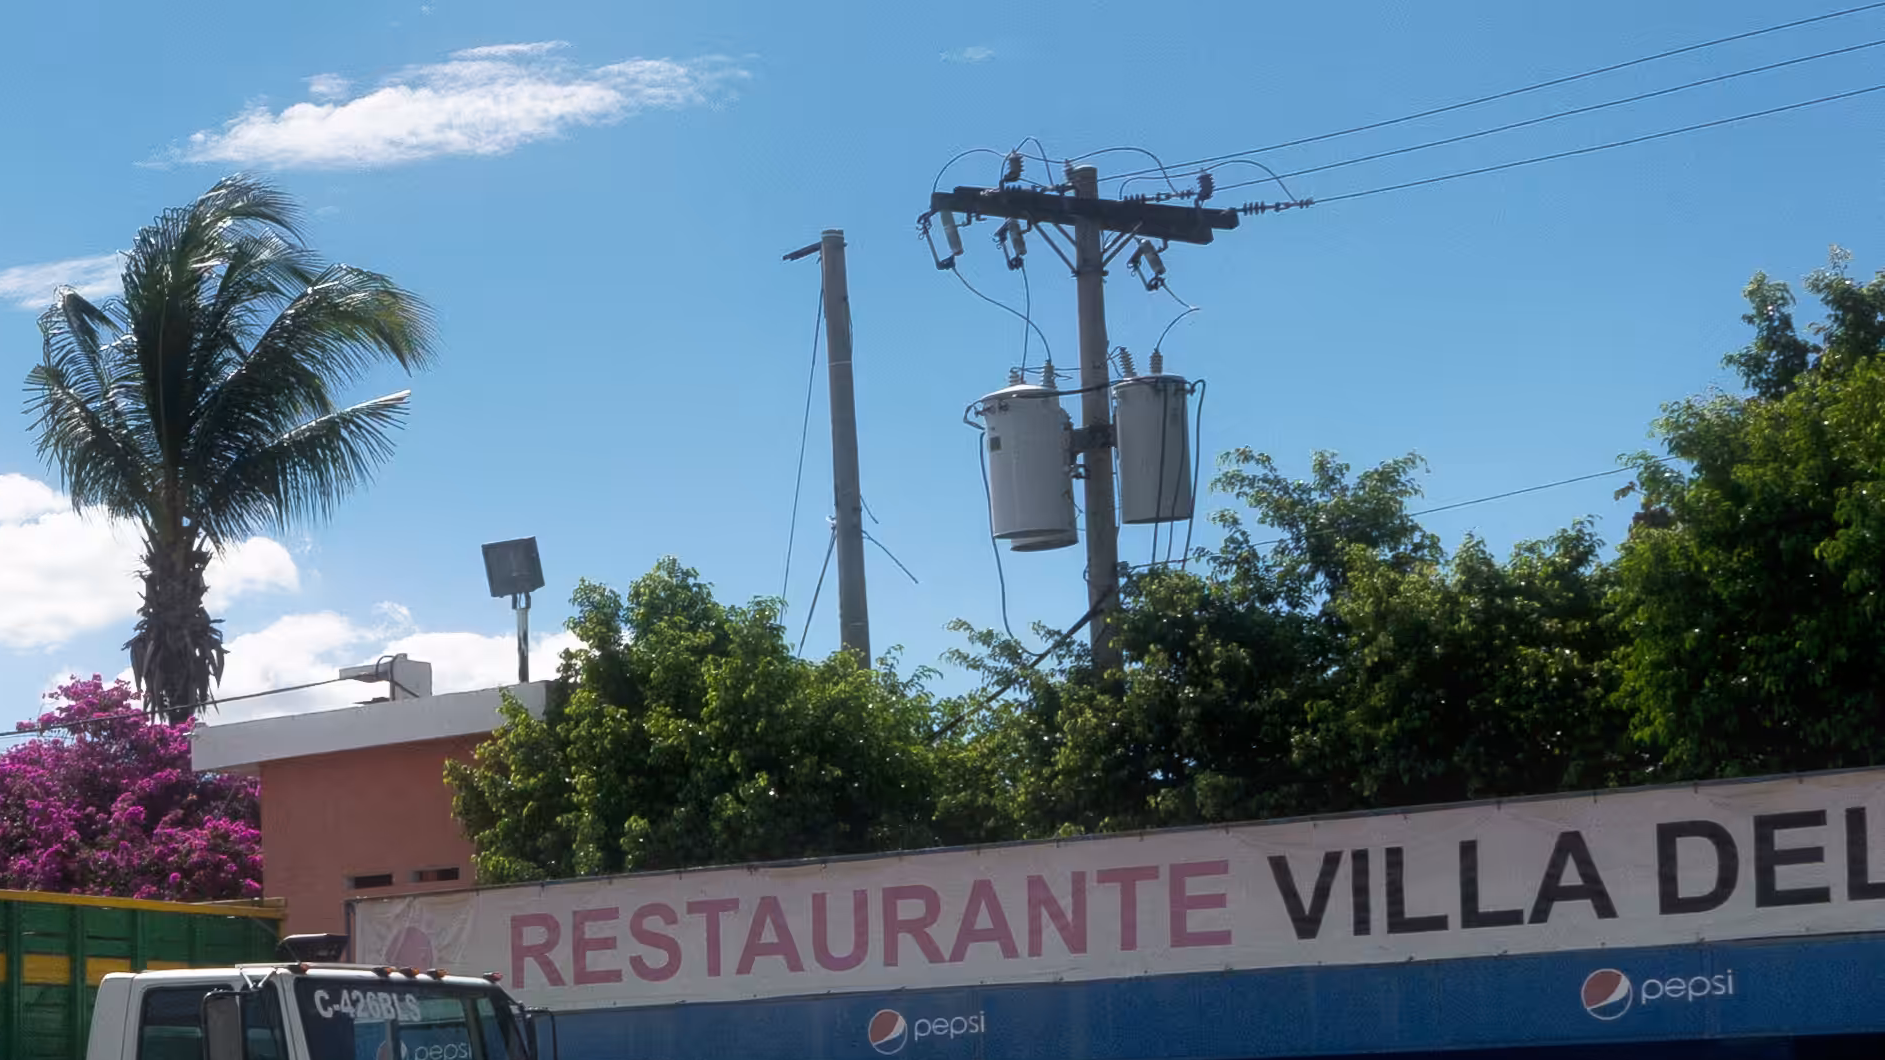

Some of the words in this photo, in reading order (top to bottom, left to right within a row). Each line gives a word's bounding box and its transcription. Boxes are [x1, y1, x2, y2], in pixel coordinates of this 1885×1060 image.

[510, 859, 1233, 990] RESTAURANTE
[1267, 830, 1619, 940] VILLA
[1656, 806, 1885, 916] DEL
[1641, 969, 1734, 1005] pepsi
[314, 989, 422, 1022] C-426BLS
[914, 1010, 986, 1042] pepsi
